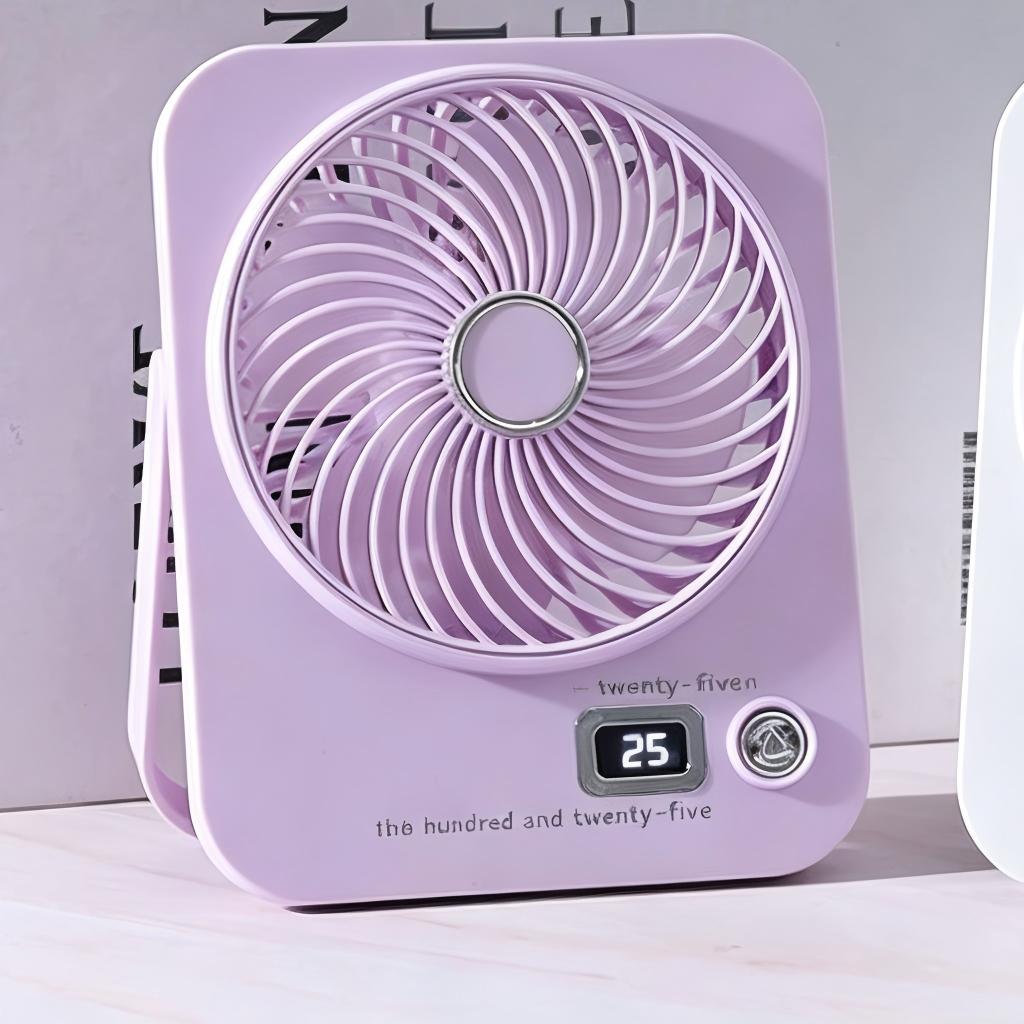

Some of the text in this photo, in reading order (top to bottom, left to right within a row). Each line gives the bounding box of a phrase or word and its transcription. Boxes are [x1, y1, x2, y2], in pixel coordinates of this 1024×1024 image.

[621, 732, 669, 768] 25
[424, 811, 513, 835] hundred
[523, 809, 564, 829] and
[573, 800, 712, 829] twenty-five
